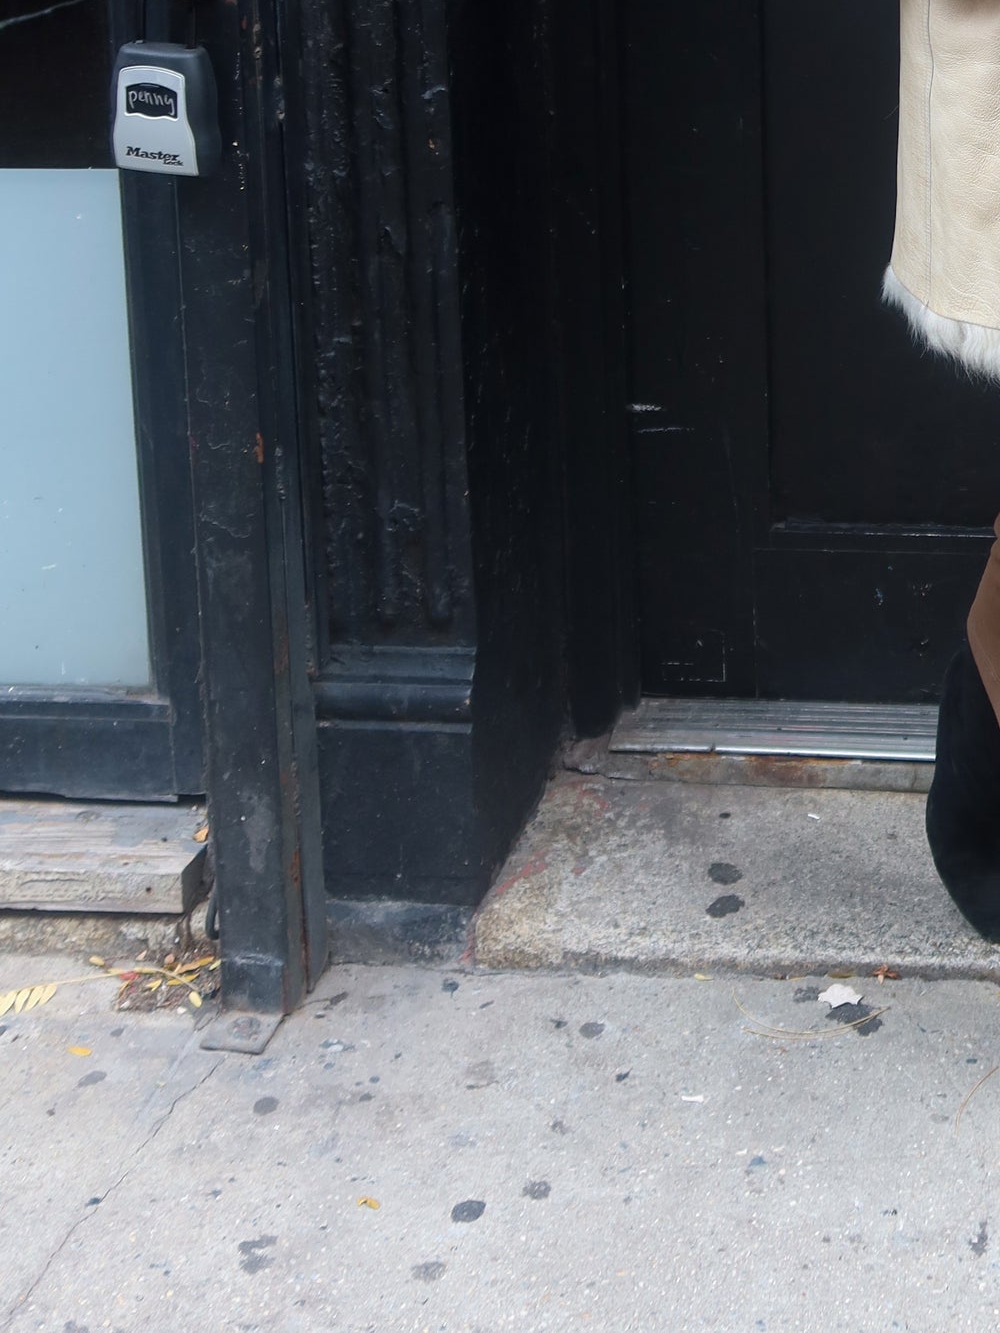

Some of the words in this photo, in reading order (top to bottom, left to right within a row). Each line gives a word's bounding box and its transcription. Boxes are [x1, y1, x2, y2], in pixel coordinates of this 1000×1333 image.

[128, 89, 175, 116] penny
[126, 146, 181, 162] Master
[162, 158, 184, 167] Lock
